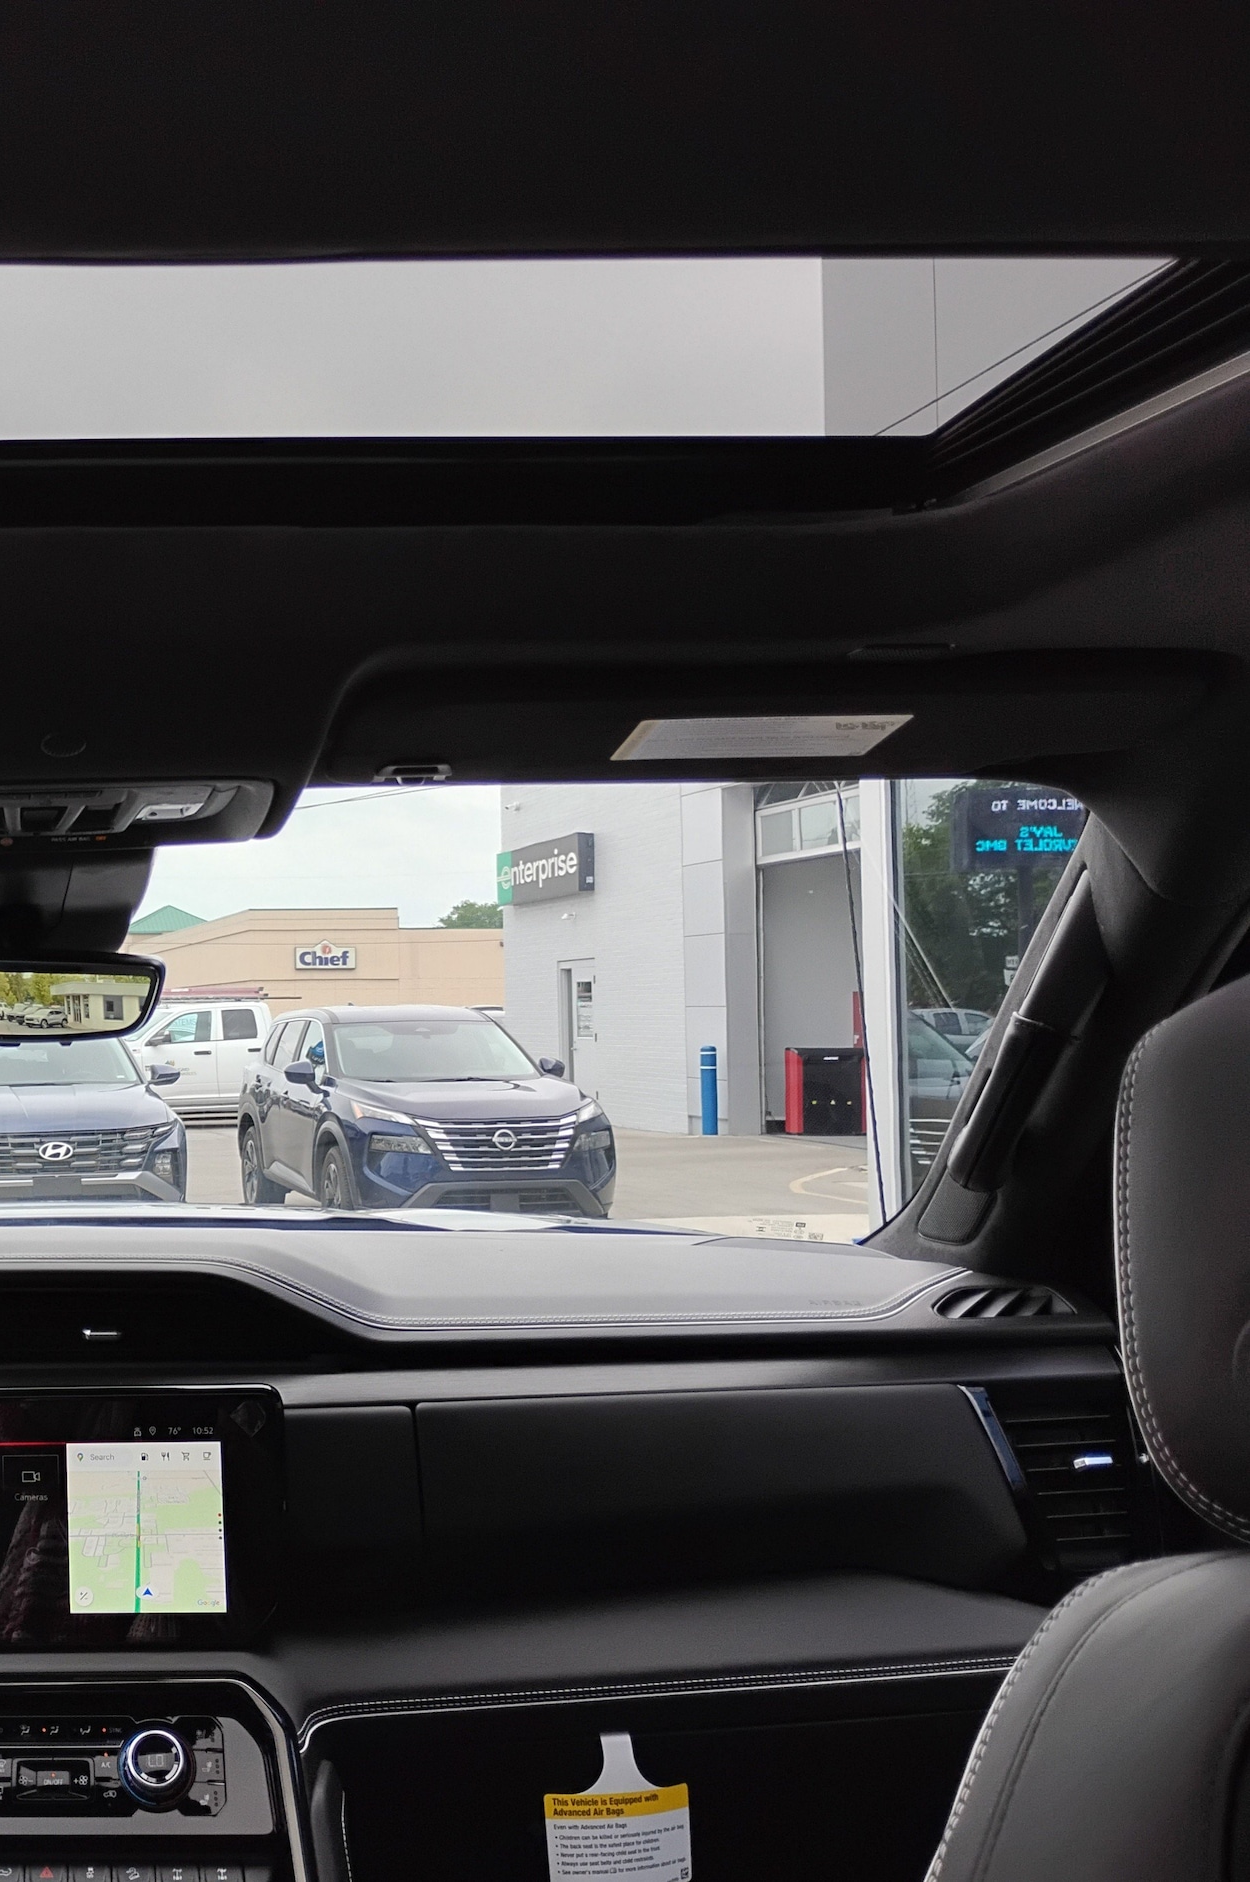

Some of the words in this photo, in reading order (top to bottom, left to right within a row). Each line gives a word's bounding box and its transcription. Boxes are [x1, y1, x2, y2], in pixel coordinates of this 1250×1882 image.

[497, 848, 577, 890] enterprise
[299, 950, 349, 966] Chief
[192, 1426, 214, 1435] 10:52
[90, 1453, 114, 1461] Search
[14, 1493, 48, 1502] Cameras
[197, 1598, 220, 1607] Google
[552, 1798, 568, 1806] This
[570, 1797, 599, 1806] Vehicle
[600, 1797, 608, 1806] is
[609, 1796, 642, 1806] Equipped
[644, 1794, 659, 1802] with
[553, 1808, 590, 1816] Advanced
[593, 1808, 604, 1816] Air
[606, 1808, 624, 1816] Bags
